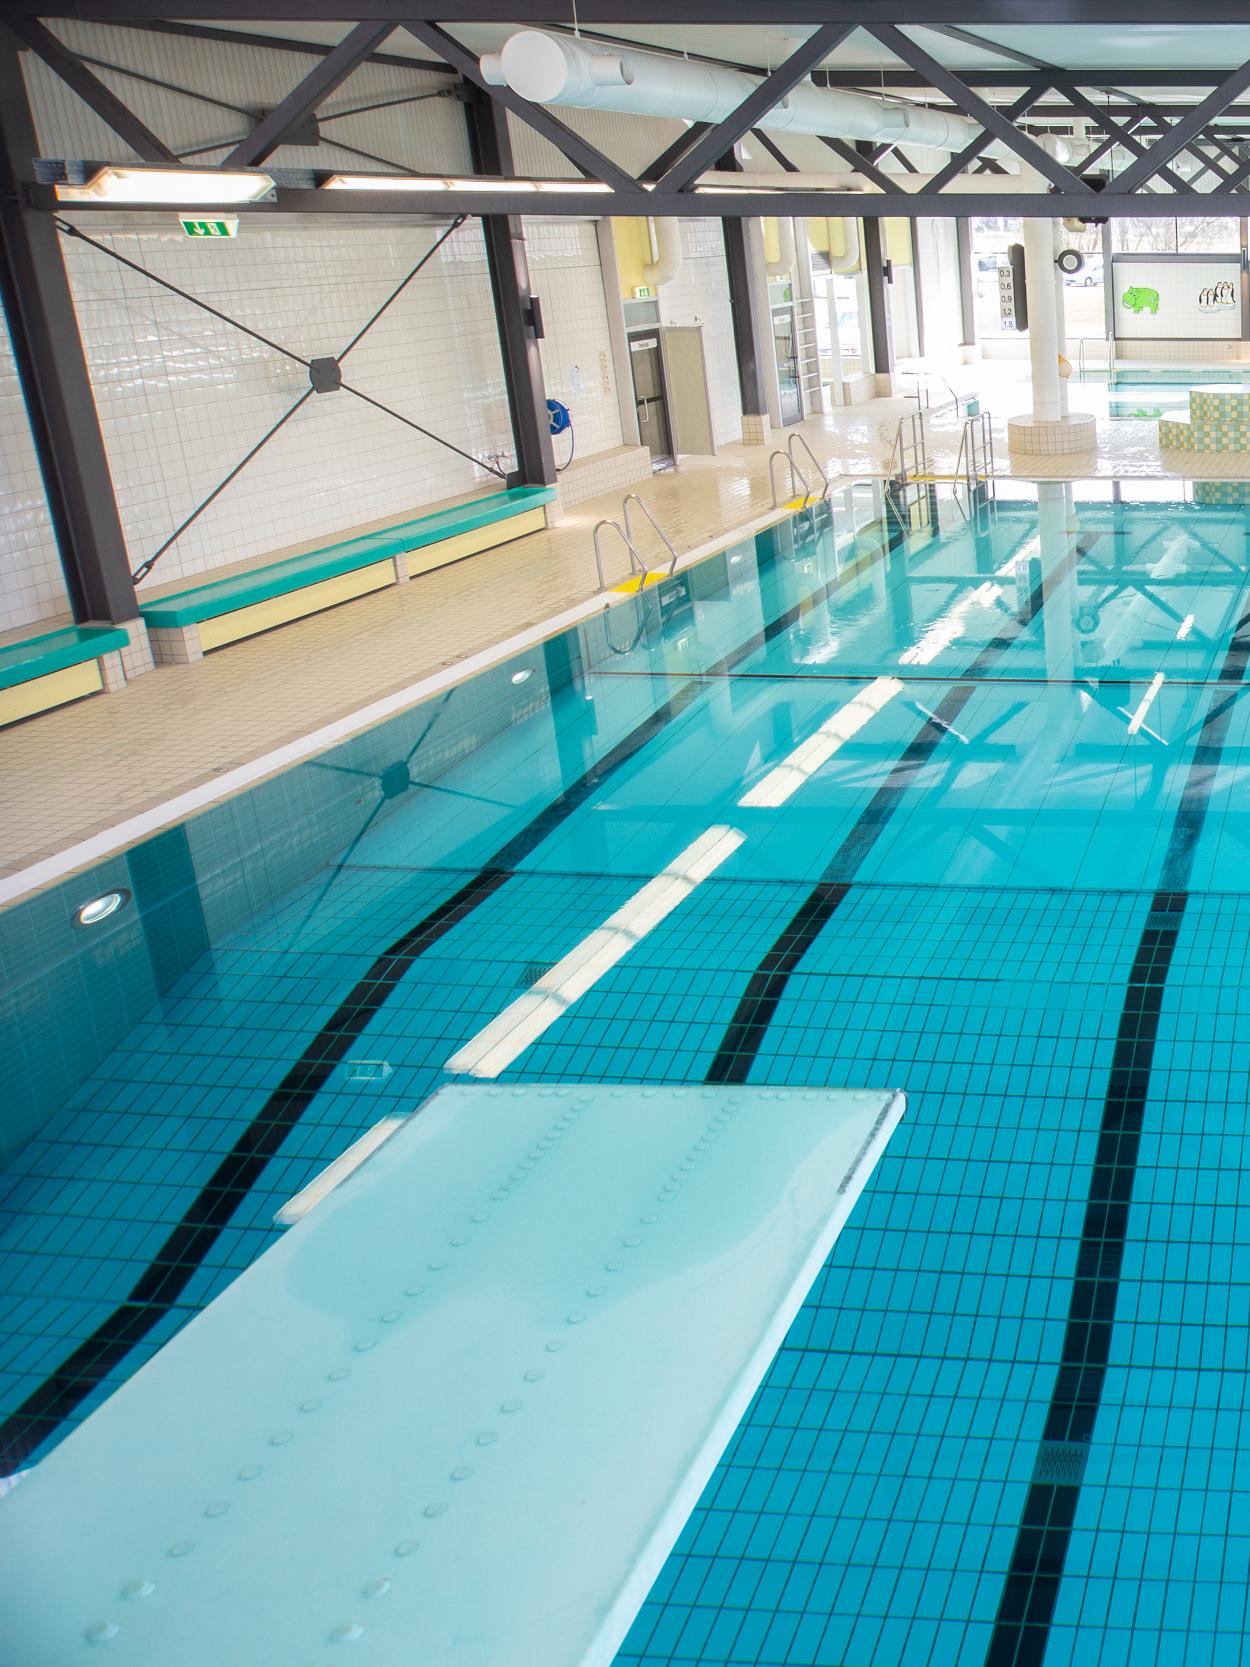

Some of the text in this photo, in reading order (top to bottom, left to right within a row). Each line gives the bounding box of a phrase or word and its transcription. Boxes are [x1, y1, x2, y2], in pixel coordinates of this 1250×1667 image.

[1000, 269, 1011, 278] 0,3
[1000, 282, 1012, 291] 0,6
[1001, 295, 1012, 303] 0,9
